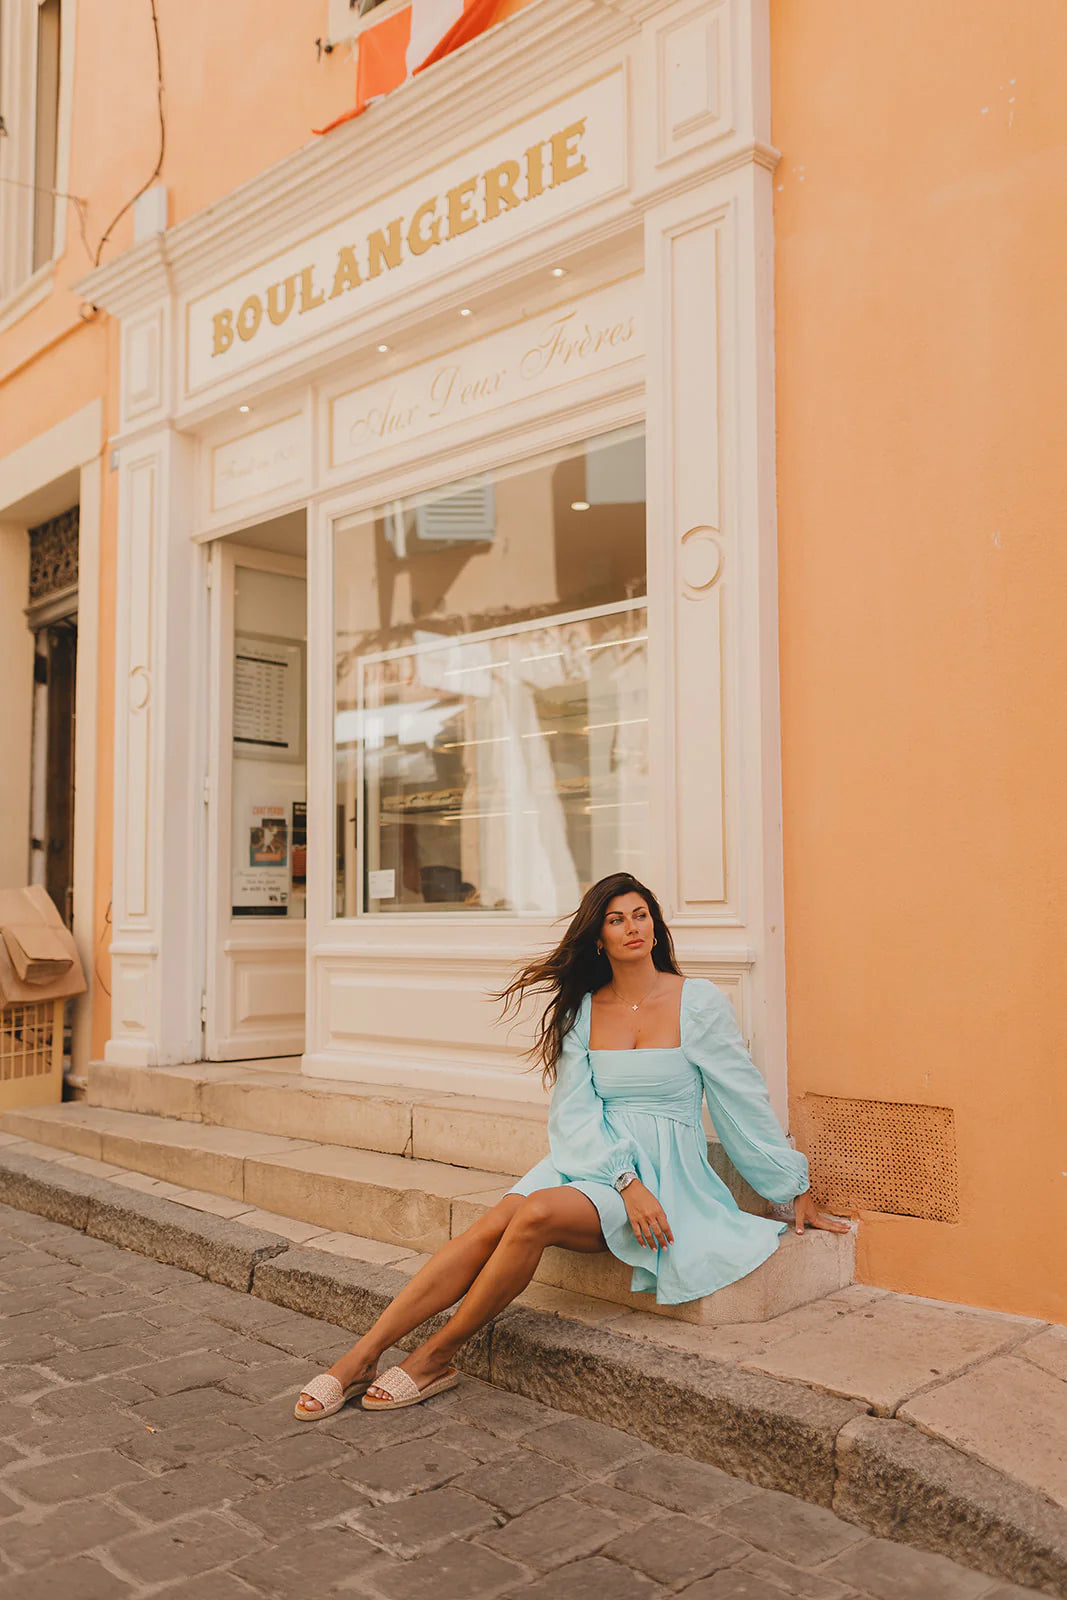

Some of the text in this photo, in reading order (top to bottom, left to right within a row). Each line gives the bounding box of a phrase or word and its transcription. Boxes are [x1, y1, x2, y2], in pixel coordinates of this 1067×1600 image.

[211, 116, 589, 357] BOULANGERIE
[349, 310, 635, 446] Aux Deux Frères
